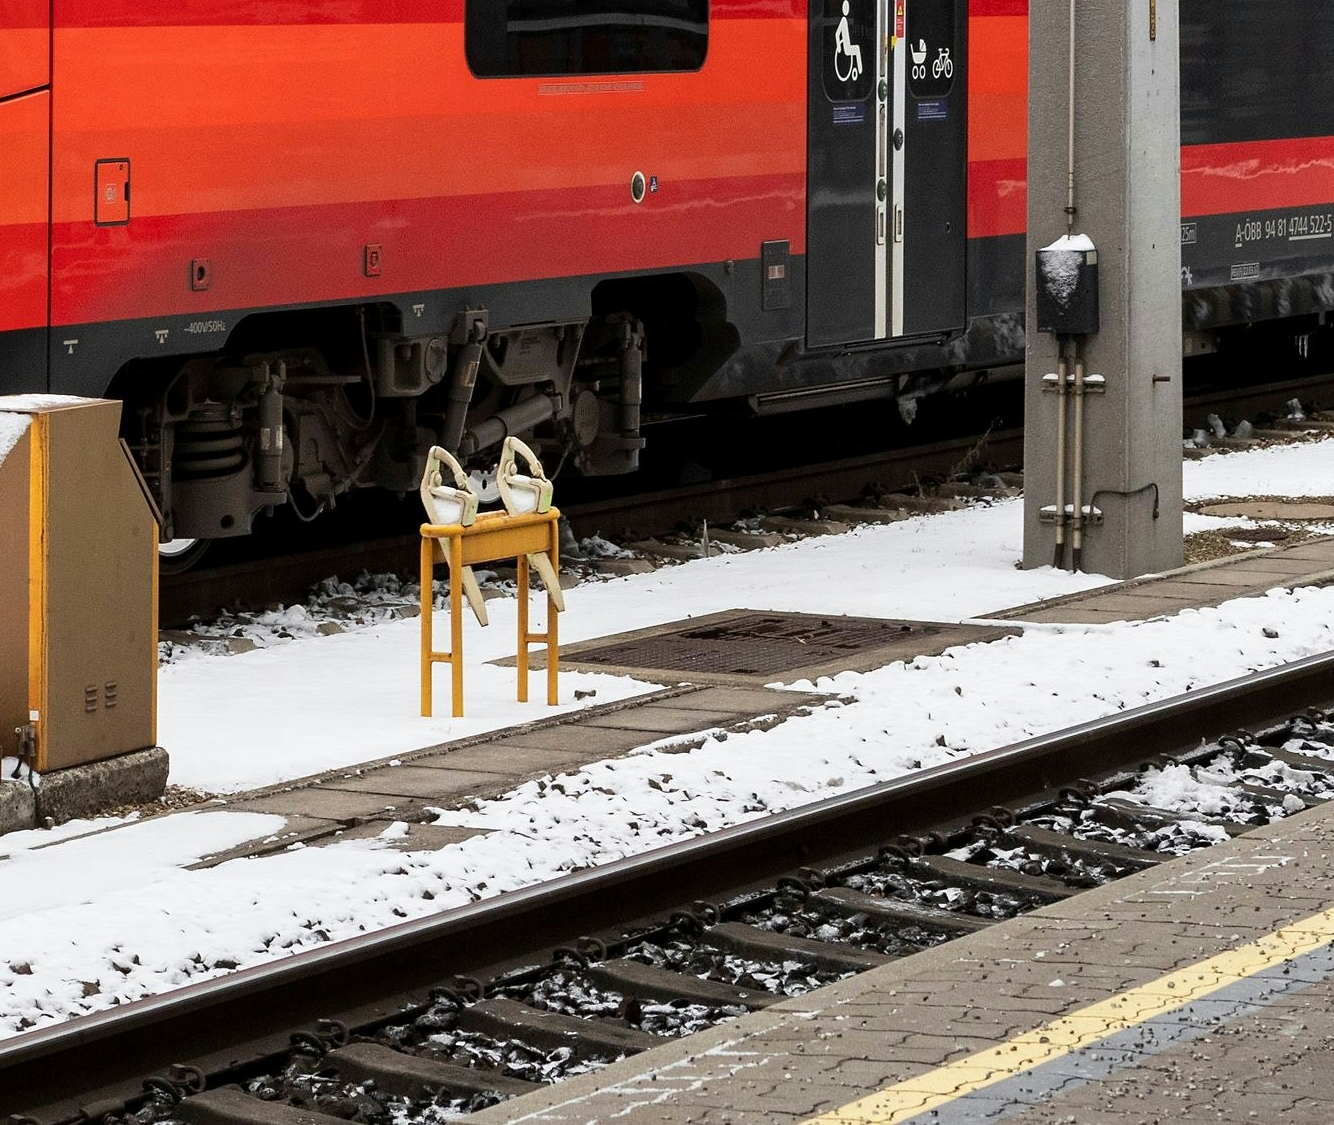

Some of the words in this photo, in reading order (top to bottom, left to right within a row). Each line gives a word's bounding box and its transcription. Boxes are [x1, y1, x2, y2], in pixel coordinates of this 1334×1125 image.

[1235, 218, 1262, 244] A-ÖBB
[1265, 220, 1276, 239] 94
[1277, 218, 1287, 237] 81
[1288, 216, 1308, 236] 4744
[1309, 214, 1332, 234] 522-5
